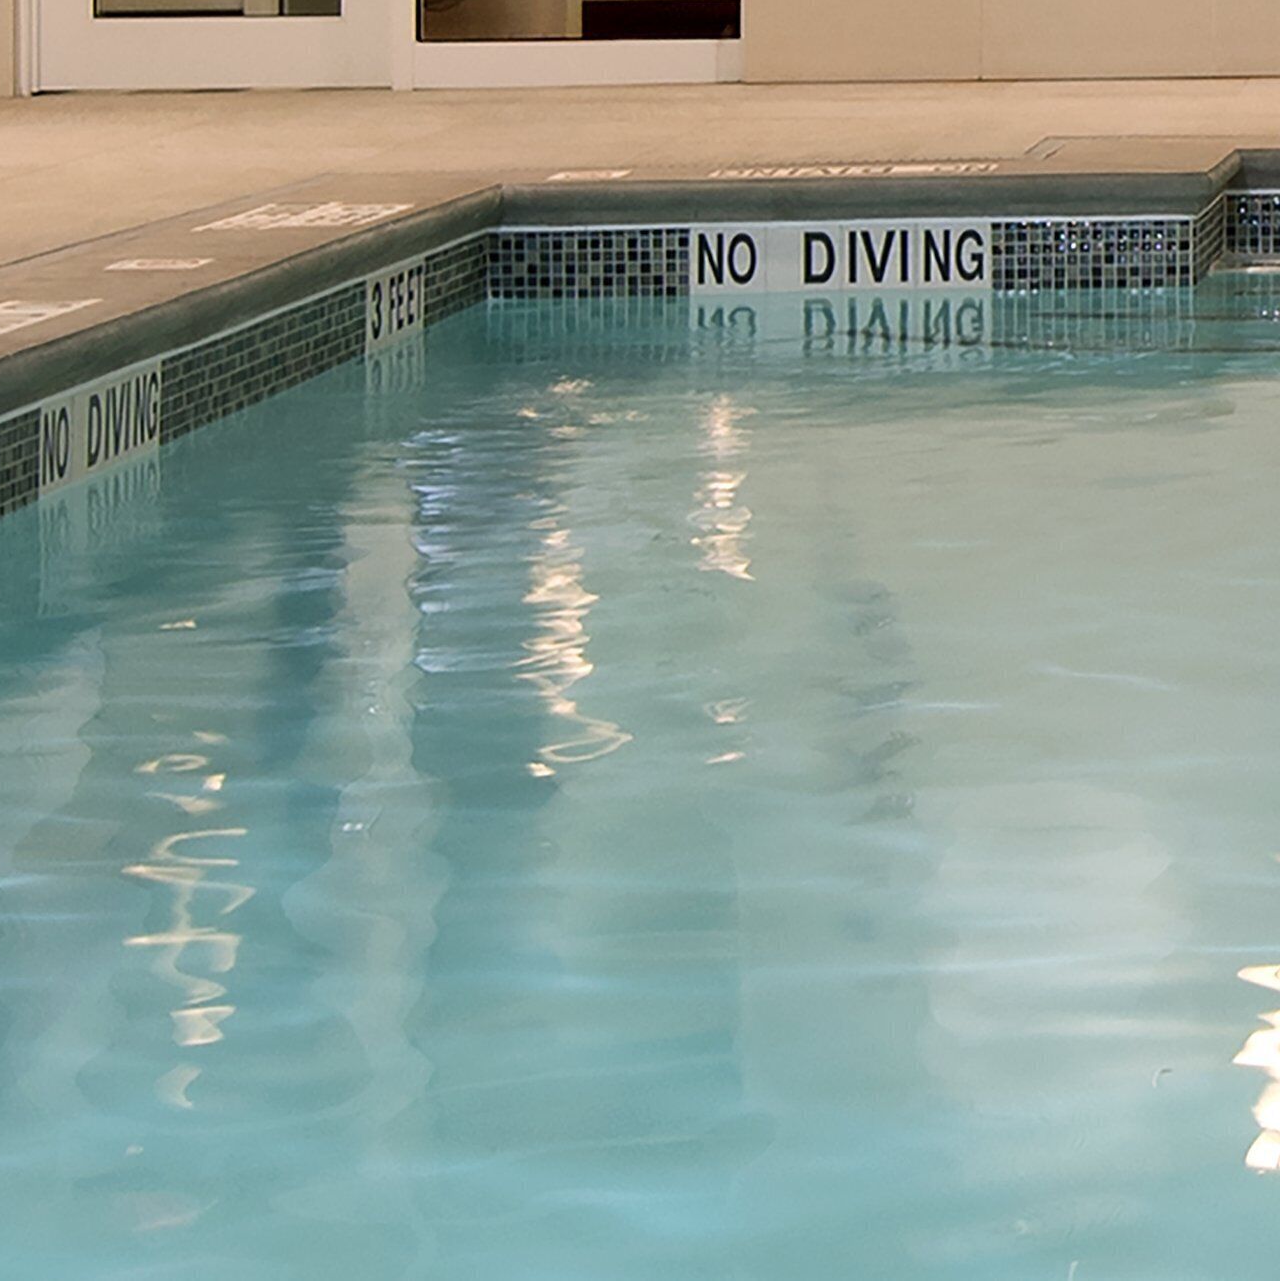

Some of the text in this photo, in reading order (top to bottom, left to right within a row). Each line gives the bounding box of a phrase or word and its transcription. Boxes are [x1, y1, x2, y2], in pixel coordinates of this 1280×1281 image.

[697, 229, 985, 285] NO DIVING
[371, 265, 423, 340] 3 FEET
[42, 371, 159, 486] NO DIVING
